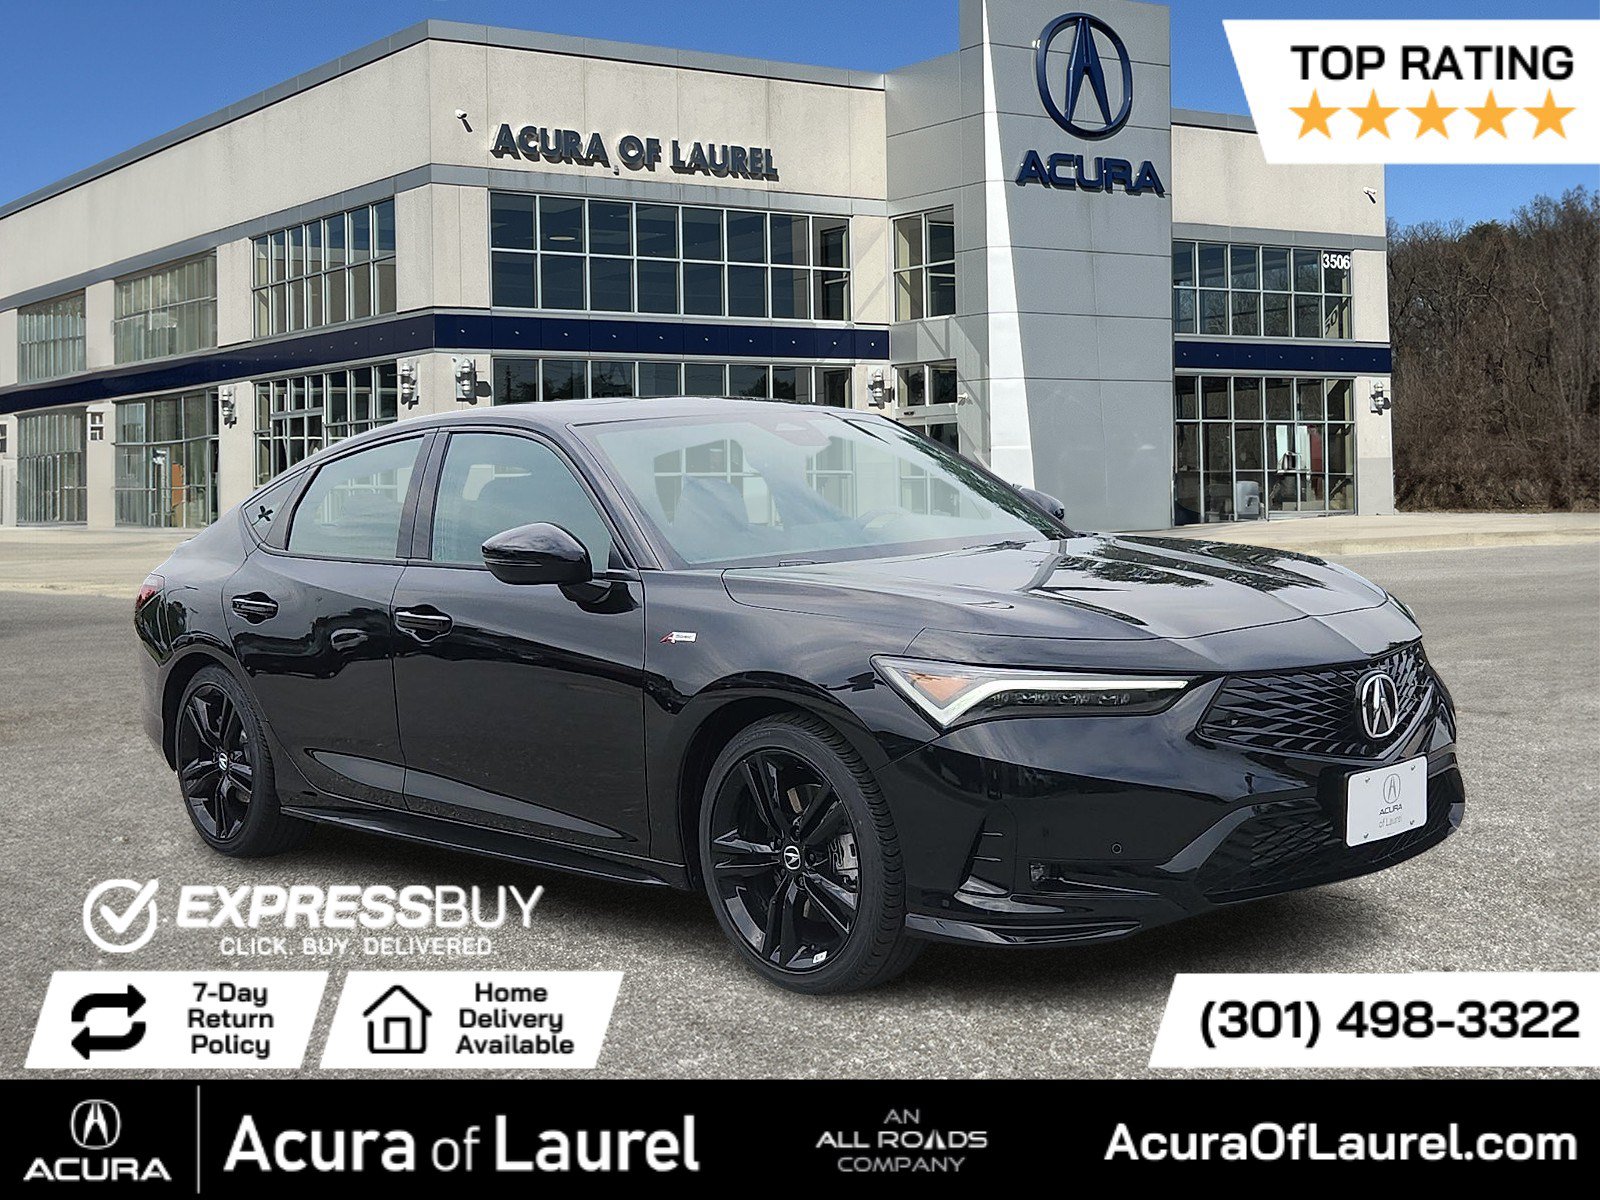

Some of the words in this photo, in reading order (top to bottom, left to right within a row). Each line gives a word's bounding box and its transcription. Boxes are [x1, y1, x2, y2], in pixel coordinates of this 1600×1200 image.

[491, 123, 610, 167] ACURA
[618, 135, 661, 171] OF
[670, 139, 778, 181] LAUREL
[1015, 150, 1166, 198] ACURA
[1322, 254, 1350, 270] 3506
[1379, 804, 1403, 815] ACURA
